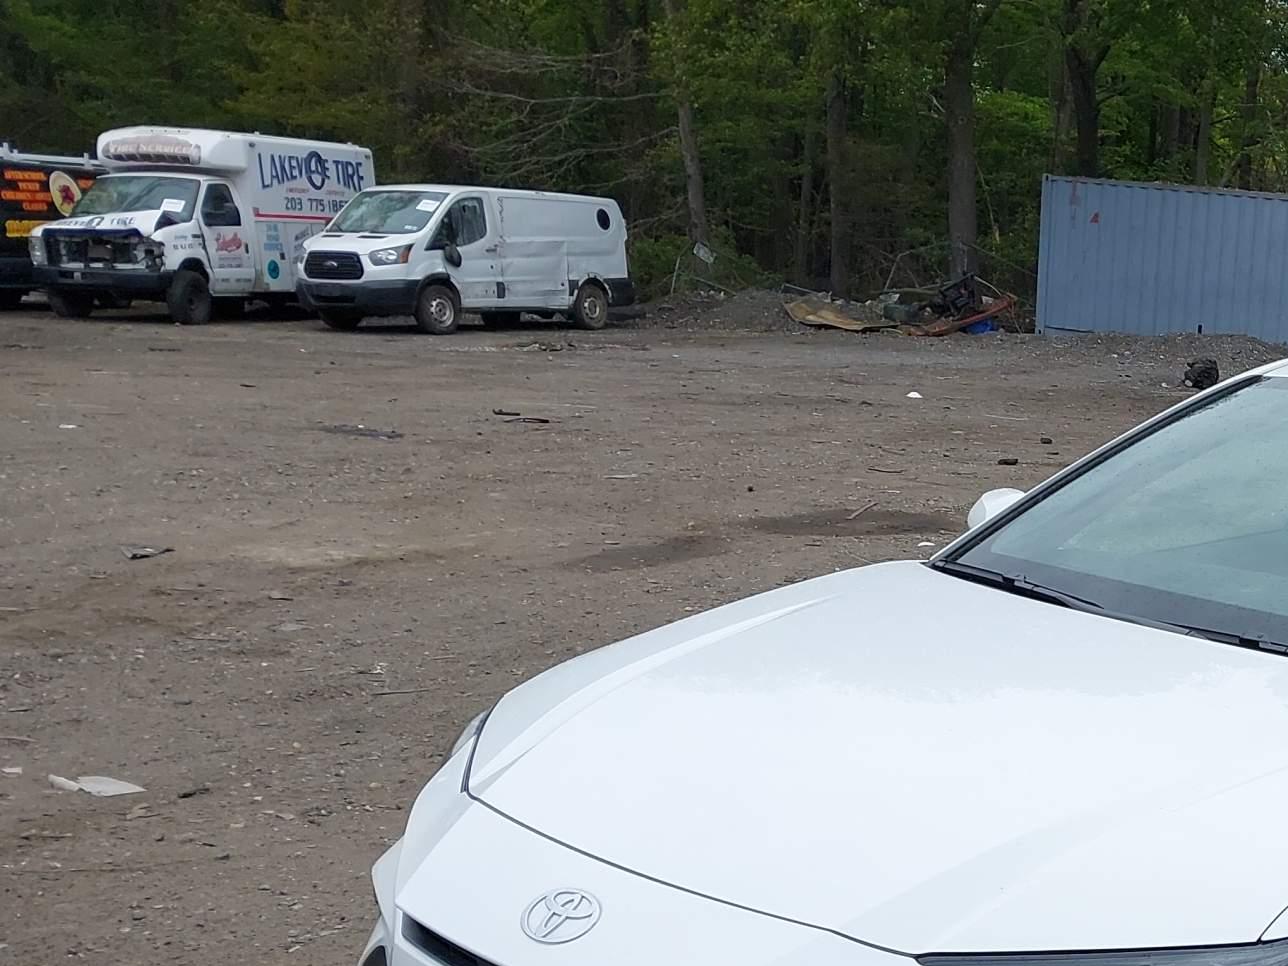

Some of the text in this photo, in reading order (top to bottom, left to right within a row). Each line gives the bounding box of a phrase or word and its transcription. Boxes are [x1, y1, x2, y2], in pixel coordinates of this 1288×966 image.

[285, 197, 349, 213] 203 775 186
